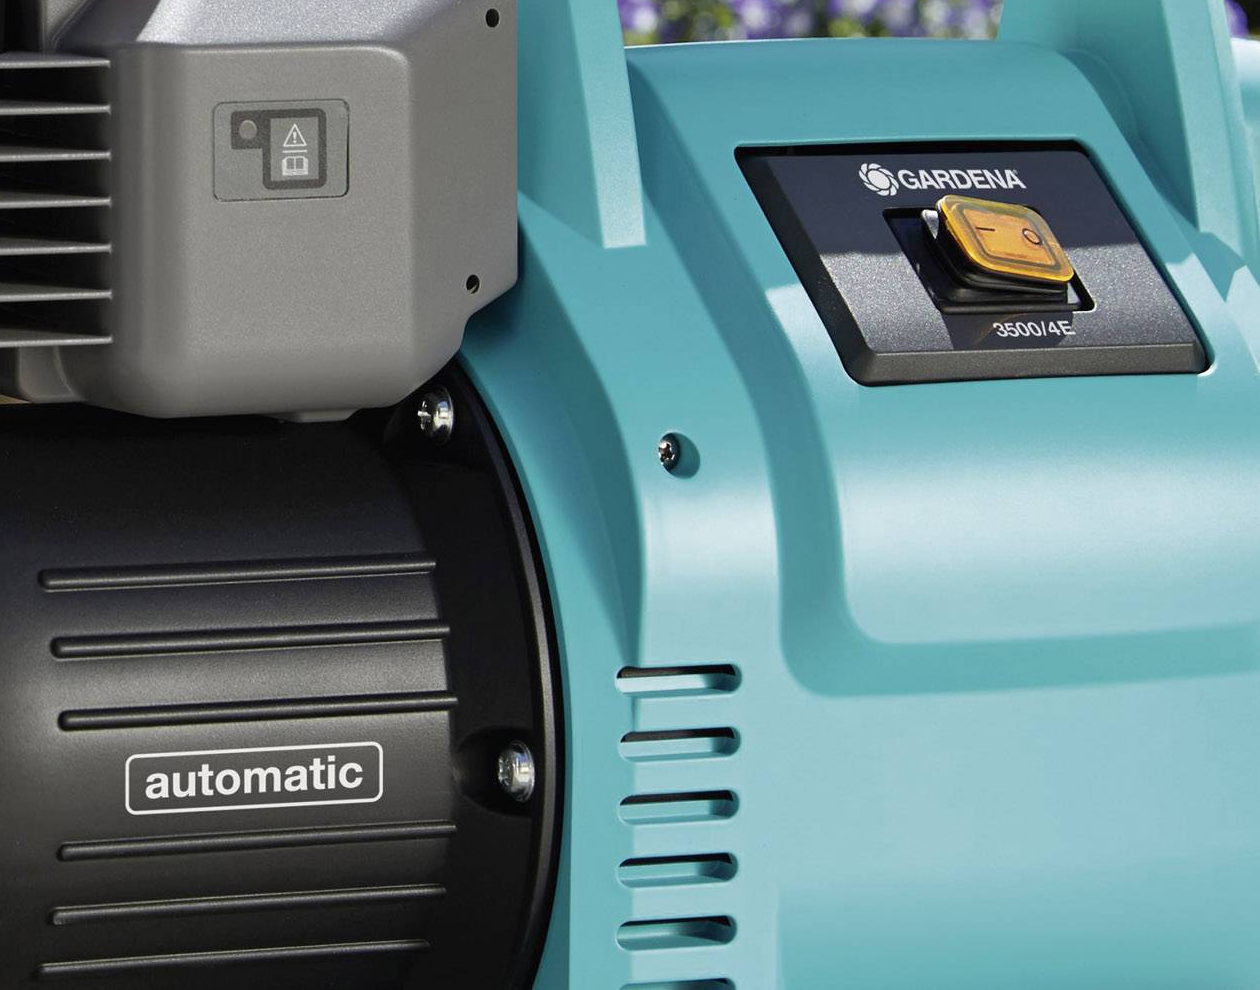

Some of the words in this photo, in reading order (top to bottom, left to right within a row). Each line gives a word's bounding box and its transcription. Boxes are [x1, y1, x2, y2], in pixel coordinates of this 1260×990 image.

[897, 169, 1027, 190] GARDENA
[992, 320, 1076, 338] 3500/4E
[145, 755, 364, 800] automatic
